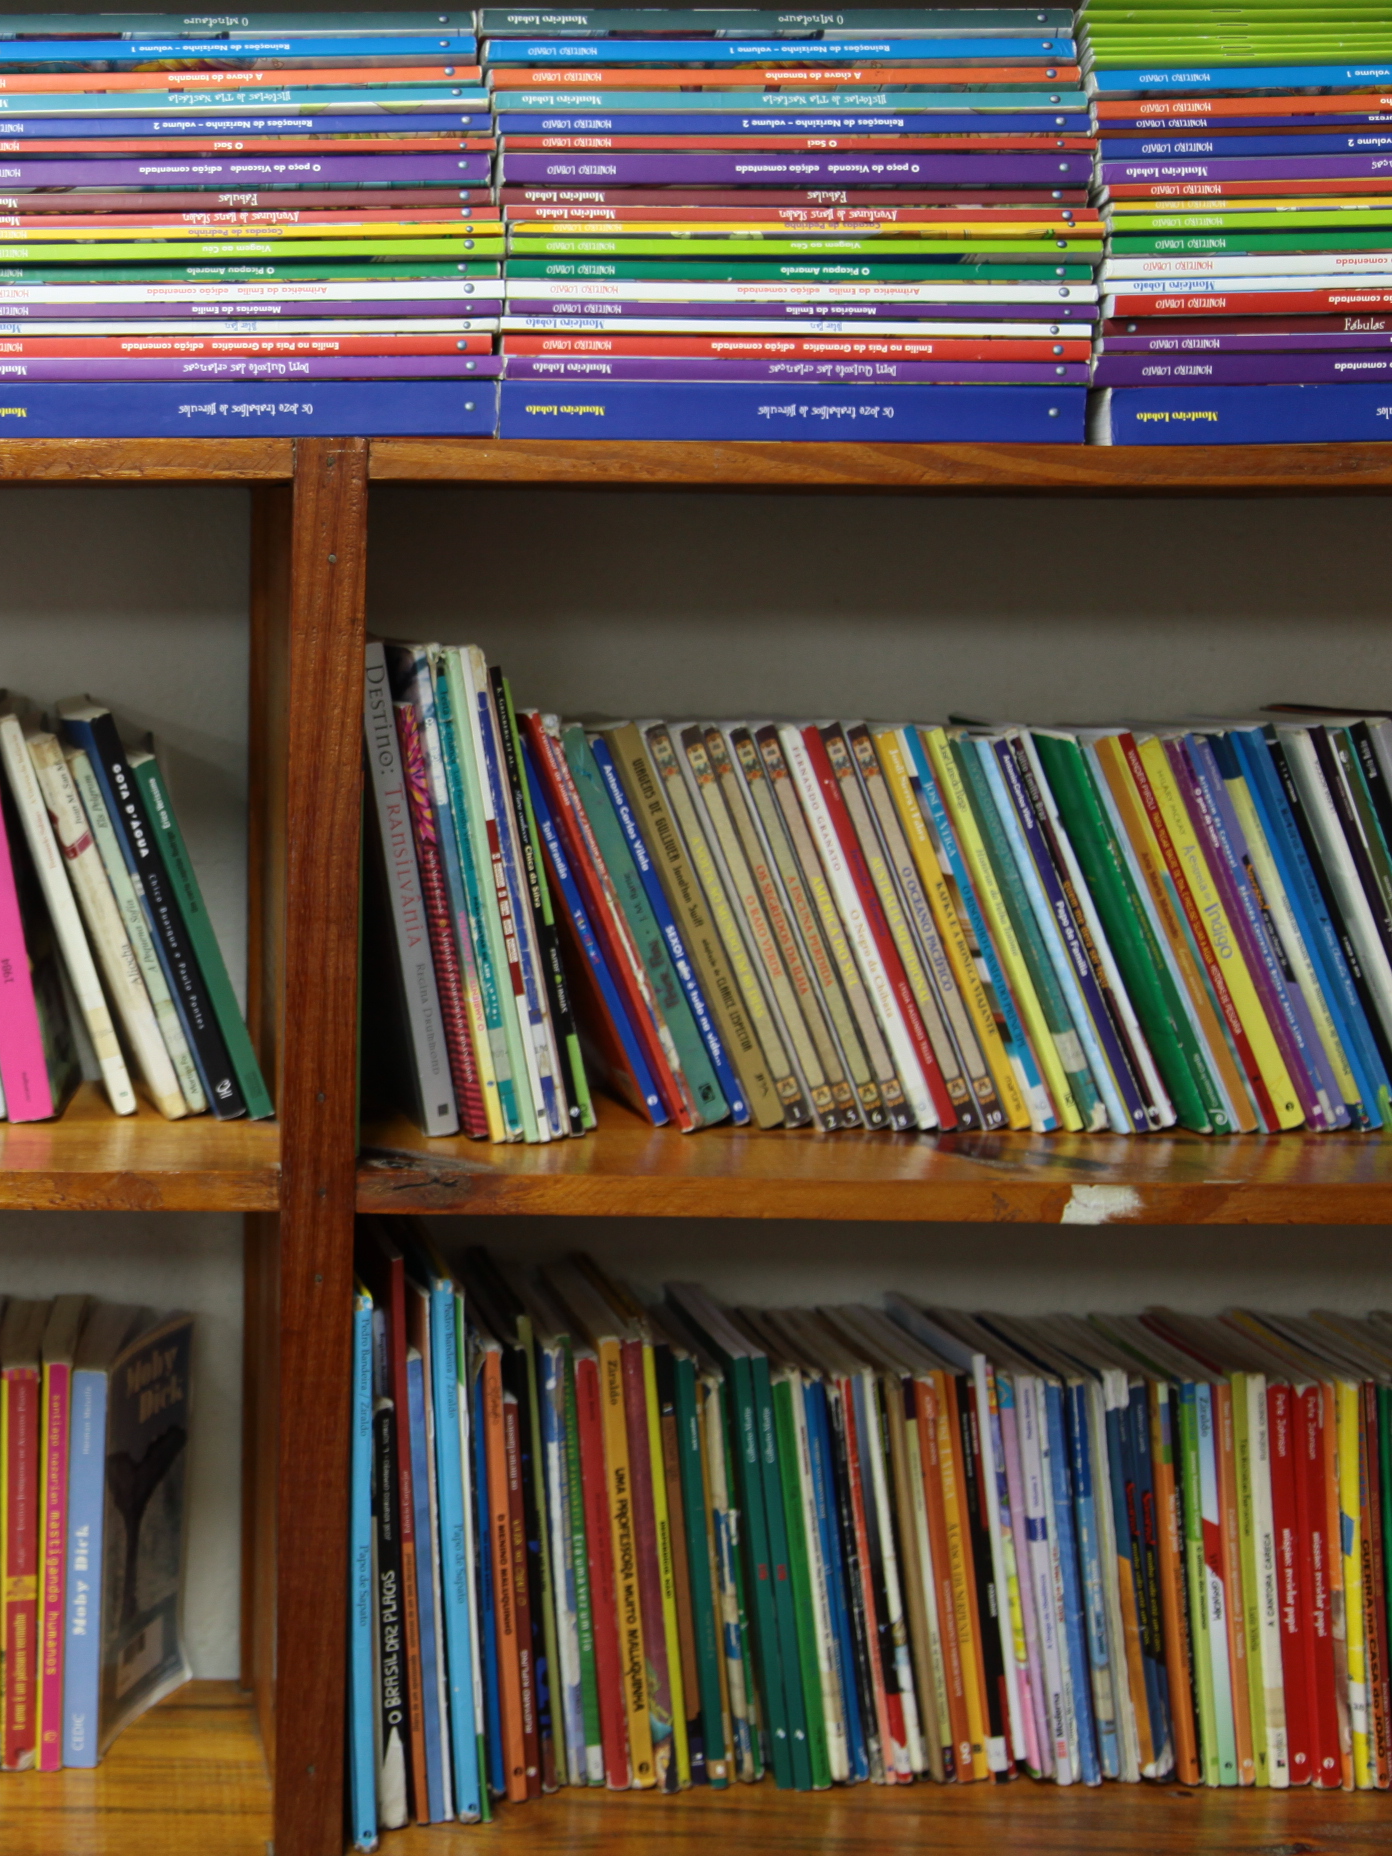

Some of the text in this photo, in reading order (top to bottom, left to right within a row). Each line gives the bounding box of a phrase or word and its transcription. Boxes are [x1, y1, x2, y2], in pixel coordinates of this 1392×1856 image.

[168, 74, 210, 83] tamanho
[211, 73, 224, 82] do
[226, 73, 254, 82] chave
[214, 141, 244, 151] O Saci
[230, 163, 322, 174] O poço do Visconde
[218, 193, 258, 206] Fábulas
[202, 244, 272, 254] Viagem ao Céu
[1344, 317, 1385, 332] Fábulas
[211, 341, 340, 352] Emília no País da Gramática
[1136, 410, 1219, 422] Monteiro Lobato
[111, 763, 132, 801] GOTA
[792, 746, 842, 873] FERNANDO GRANATO
[602, 763, 652, 873] Antonio Carlos Vilela
[717, 978, 754, 1053] CLARICE LISPECTOR
[986, 1111, 1002, 1126] 10
[606, 1358, 620, 1407] Ziraldo
[614, 1466, 627, 1498] UMA
[615, 1498, 637, 1579] PROFESSORA
[73, 1524, 90, 1635] Moby Dick
[381, 1569, 396, 1621] PLACAS
[383, 1656, 402, 1709] BRASIL
[388, 1711, 403, 1725] O
